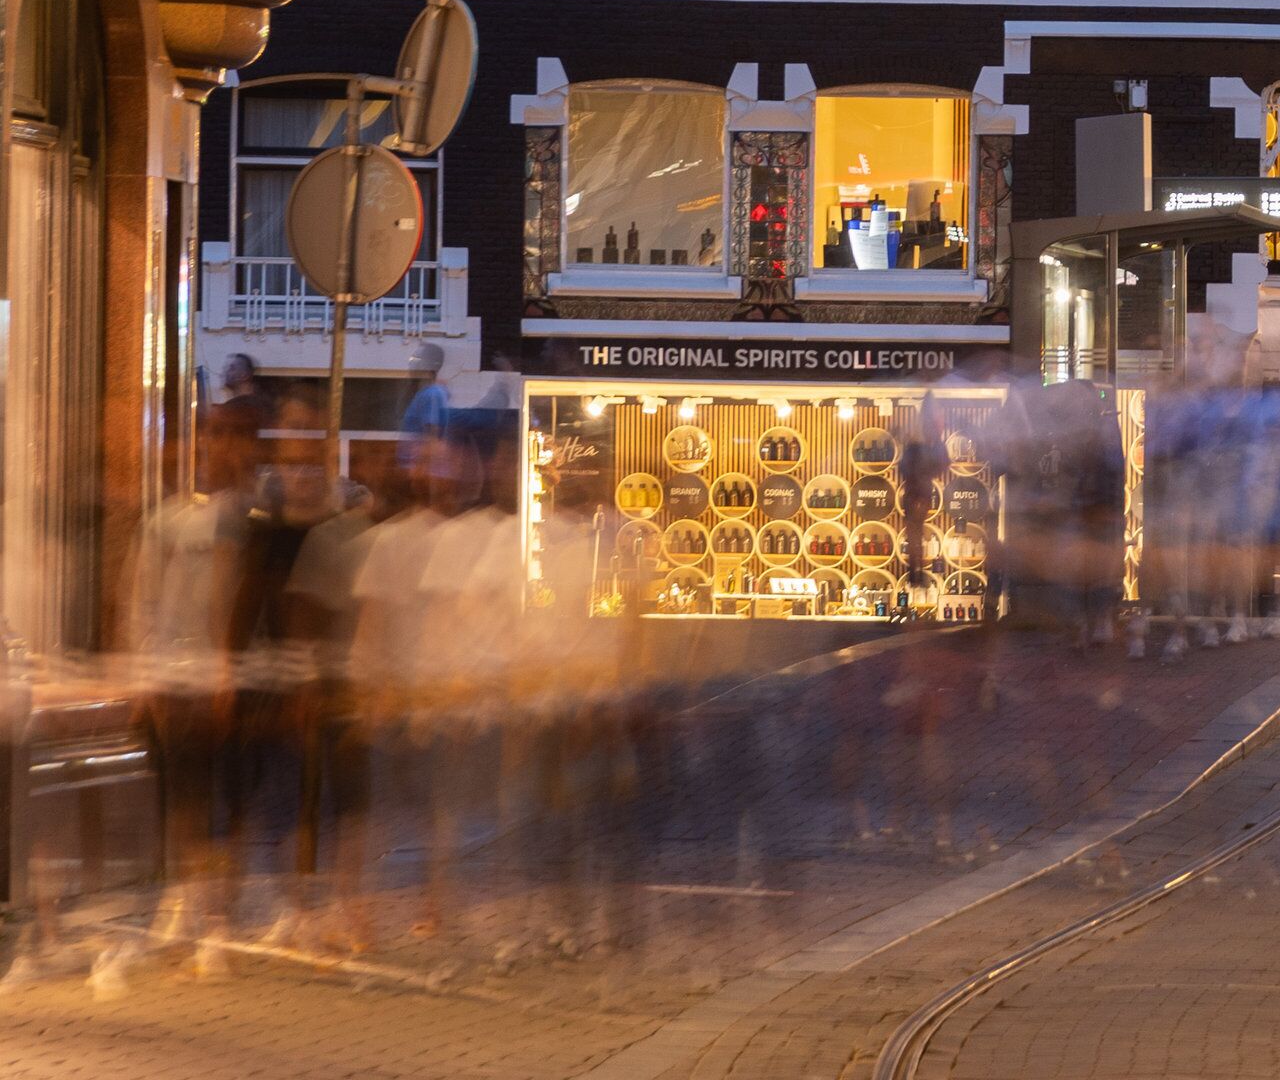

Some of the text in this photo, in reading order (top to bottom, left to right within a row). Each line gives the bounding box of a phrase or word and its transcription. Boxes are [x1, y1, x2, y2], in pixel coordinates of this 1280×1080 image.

[580, 346, 954, 370] THE ORIGINAL SPIRITS COLLECTION
[670, 487, 701, 496] BRANDY
[764, 488, 795, 497] COGNAC
[858, 489, 888, 498] WHISKY
[953, 491, 978, 499] DUTCH
